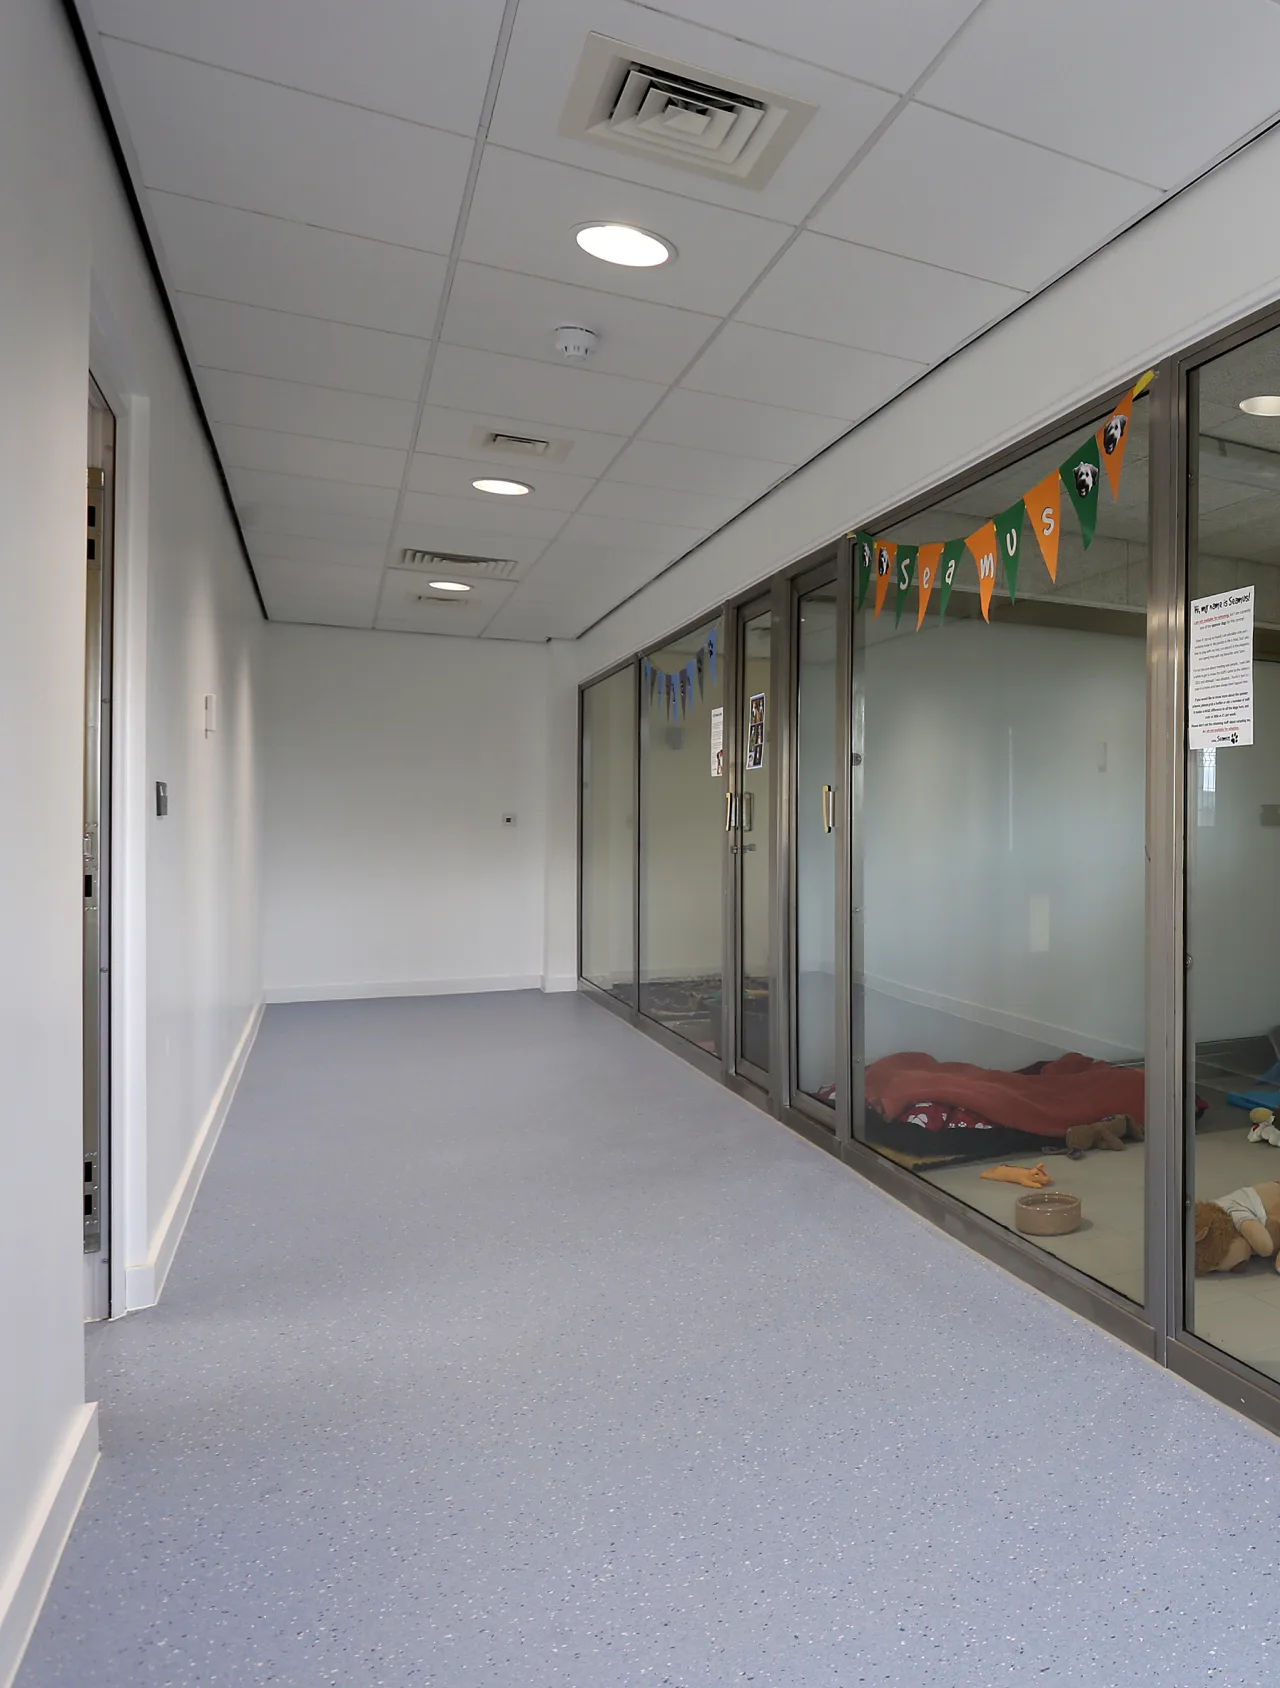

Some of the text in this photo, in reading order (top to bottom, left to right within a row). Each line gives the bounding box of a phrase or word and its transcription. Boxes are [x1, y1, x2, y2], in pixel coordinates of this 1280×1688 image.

[1201, 604, 1208, 614] my
[1210, 601, 1222, 609] name
[1223, 599, 1228, 607] is
[1228, 592, 1251, 606] Seamus!
